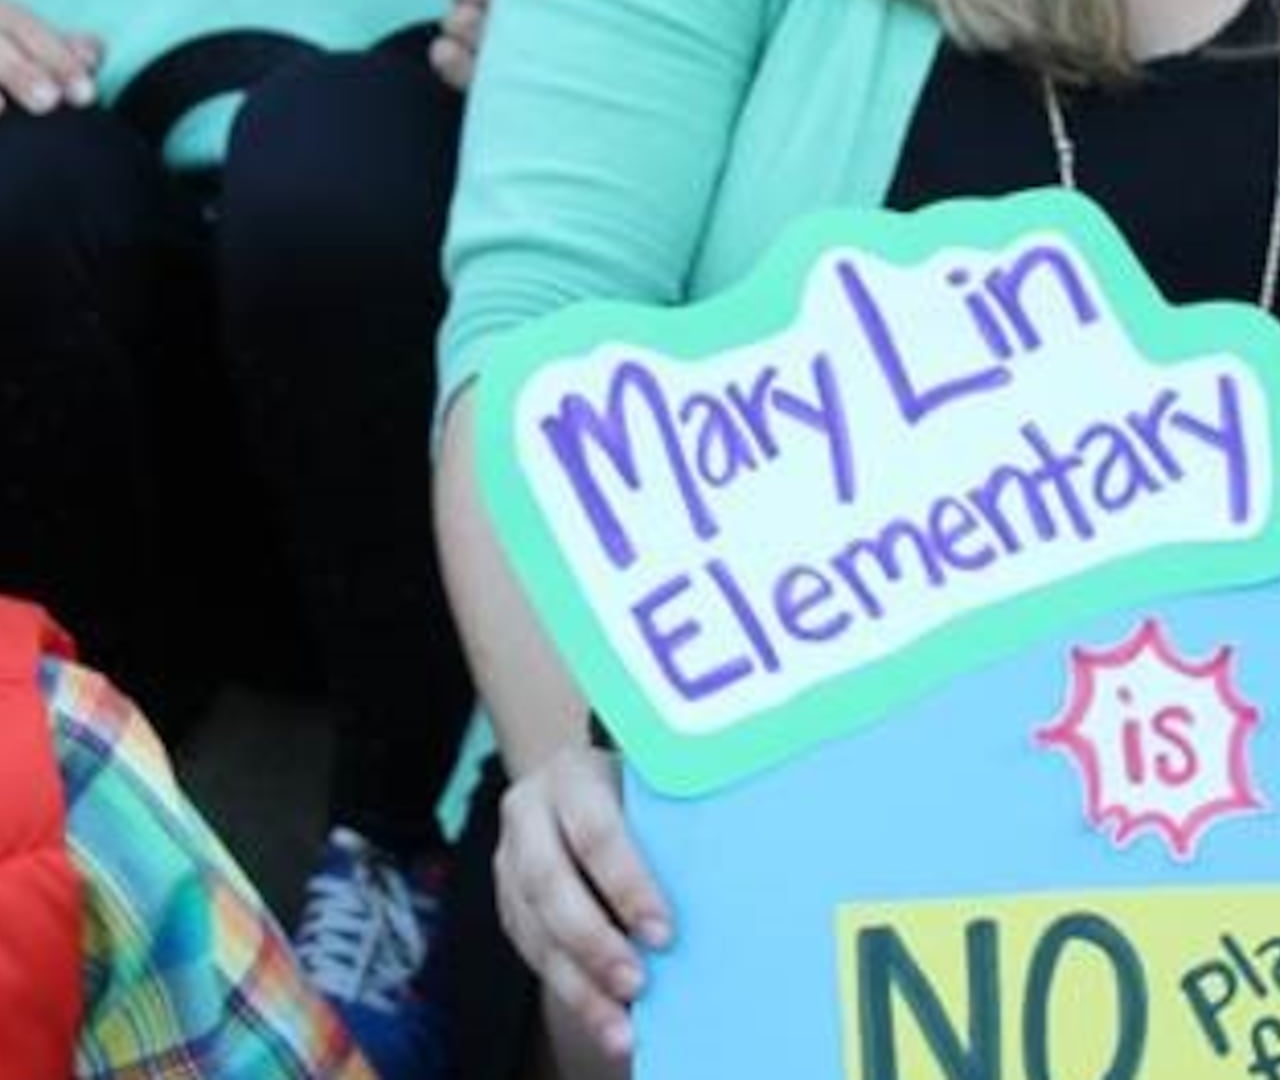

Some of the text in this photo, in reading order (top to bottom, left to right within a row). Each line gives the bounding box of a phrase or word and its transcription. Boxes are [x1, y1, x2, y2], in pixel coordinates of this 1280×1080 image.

[539, 244, 1100, 570] Mary Lin
[630, 375, 1252, 703] Elementary
[1116, 685, 1199, 786] is
[855, 912, 1150, 1080] NO
